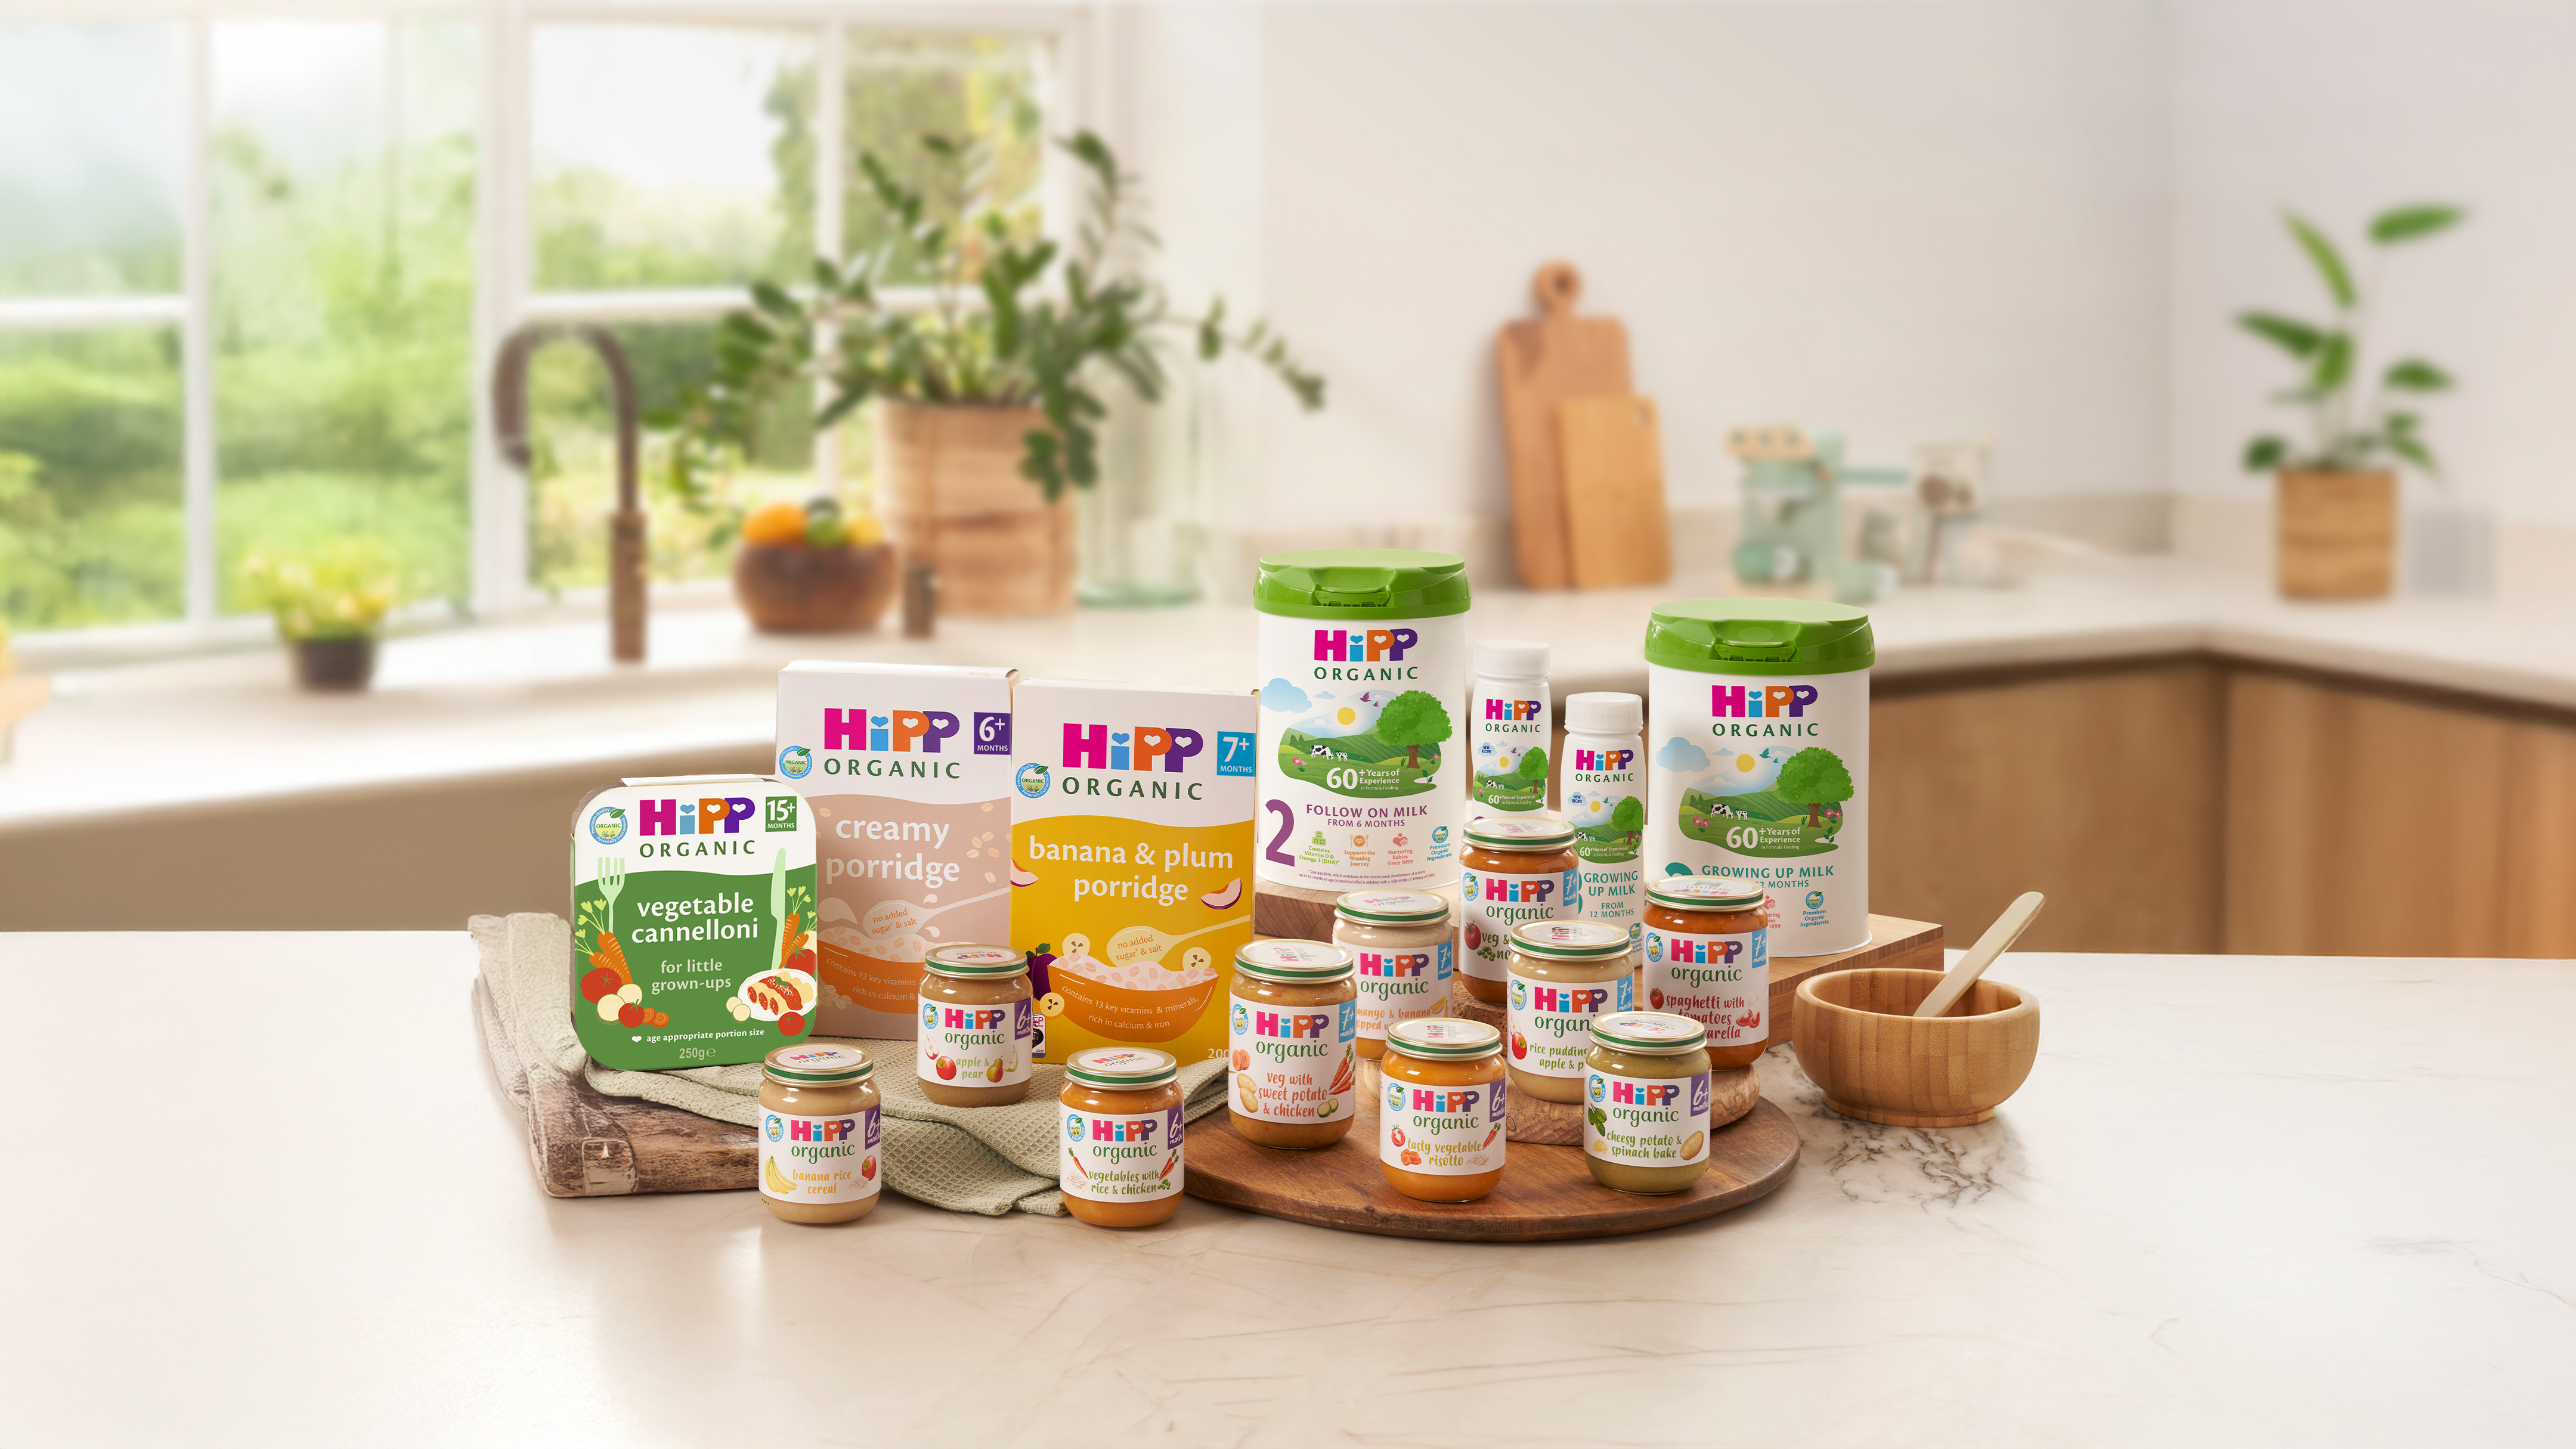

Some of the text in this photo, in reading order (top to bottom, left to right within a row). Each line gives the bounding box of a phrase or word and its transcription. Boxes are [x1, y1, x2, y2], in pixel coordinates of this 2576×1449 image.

[1314, 628, 1417, 662] HiPP
[1314, 667, 1417, 681] ORGANIC
[1486, 699, 1541, 720] HiPP
[1712, 685, 1818, 717] HiPP
[824, 708, 959, 753] HiPP
[979, 716, 1005, 742] 6+
[1485, 723, 1540, 733] ORGANIC
[1712, 723, 1818, 736] ORGANIC
[1063, 723, 1203, 773] HiPP
[1223, 736, 1249, 762] 7+
[824, 758, 959, 779] ORGANIC
[1576, 749, 1634, 770] HiPP
[1327, 767, 1358, 789] 60
[1575, 773, 1634, 782] ORGANIC
[1063, 777, 1203, 800] ORGANIC
[639, 797, 756, 836] HiPP
[767, 800, 795, 821] 15+
[1306, 804, 1428, 818] FOLLOW ON MILK
[836, 819, 949, 849] creamy
[1265, 799, 1295, 867] 2
[1328, 819, 1354, 827] FROM
[1364, 819, 1405, 828] MONTHS
[1726, 826, 1758, 849] 60
[639, 840, 755, 857] ORGANIC
[1030, 835, 1233, 872] banana & plum
[1427, 852, 1452, 861] Ingredients
[826, 853, 960, 888] porridge
[1584, 871, 1639, 884] GROWING
[1702, 865, 1834, 878] GROWING UP MILK
[1075, 875, 1188, 906] porridge
[1486, 878, 1555, 903] HiPP
[1589, 884, 1636, 896] UP MILK
[1768, 880, 1809, 888] MONTHS
[637, 892, 754, 922] vegetable
[885, 909, 908, 920] added
[1486, 903, 1554, 926] organic
[1601, 909, 1634, 917] MONTHS
[631, 918, 758, 943] cannelloni
[904, 918, 917, 927] salt
[1130, 934, 1154, 946] added
[1148, 944, 1162, 953] salt
[1671, 939, 1743, 964] HiPP
[661, 959, 723, 974] for little
[826, 958, 916, 986] contains 12 key vitamins
[1360, 953, 1429, 977] HiPP
[652, 977, 731, 994] grown-ups
[1671, 965, 1742, 988] organic
[853, 986, 867, 996] rich
[878, 991, 907, 1000] calcium
[1062, 986, 1199, 1014] contains 13 key vitamins minerals,
[1361, 978, 1429, 1001] organic
[1535, 986, 1608, 1013] HiPP
[1398, 1008, 1431, 1019] banana
[1666, 995, 1744, 1011] spaghetti with
[945, 1008, 1005, 1029] HiPP
[1088, 1014, 1103, 1024] rich
[1114, 1020, 1144, 1029] calcium
[1256, 1011, 1329, 1039] HiPP
[646, 1035, 661, 1043] age
[663, 1032, 713, 1042] appropriate
[716, 1030, 747, 1040] portion
[945, 1030, 1005, 1051] organic
[1256, 1040, 1329, 1064] organic
[1530, 1043, 1546, 1054] rice
[956, 1056, 982, 1069] apple
[1540, 1058, 1565, 1070] apple
[962, 1070, 983, 1080] pear
[1289, 1073, 1312, 1085] with
[1259, 1086, 1327, 1105] sweet potato
[1413, 1088, 1479, 1113] HiPP
[1613, 1081, 1680, 1106] HiPP
[1263, 1103, 1315, 1118] & chicken
[1613, 1107, 1679, 1128] organic
[791, 1119, 855, 1141] HiPP
[1092, 1119, 1157, 1142] HiPP
[1413, 1113, 1479, 1135] organic
[1407, 1138, 1481, 1156] tasty vegetable
[1607, 1131, 1673, 1147] cheesy potato
[791, 1141, 855, 1164] organic
[1092, 1142, 1157, 1165] organic
[1429, 1155, 1463, 1167] risotto
[1612, 1145, 1676, 1159] spinach bake
[793, 1169, 852, 1181] banana rice
[1089, 1169, 1159, 1183] vegetables with
[807, 1183, 837, 1194] cereal
[1091, 1182, 1109, 1194] rice
[1121, 1182, 1156, 1194] chicken
